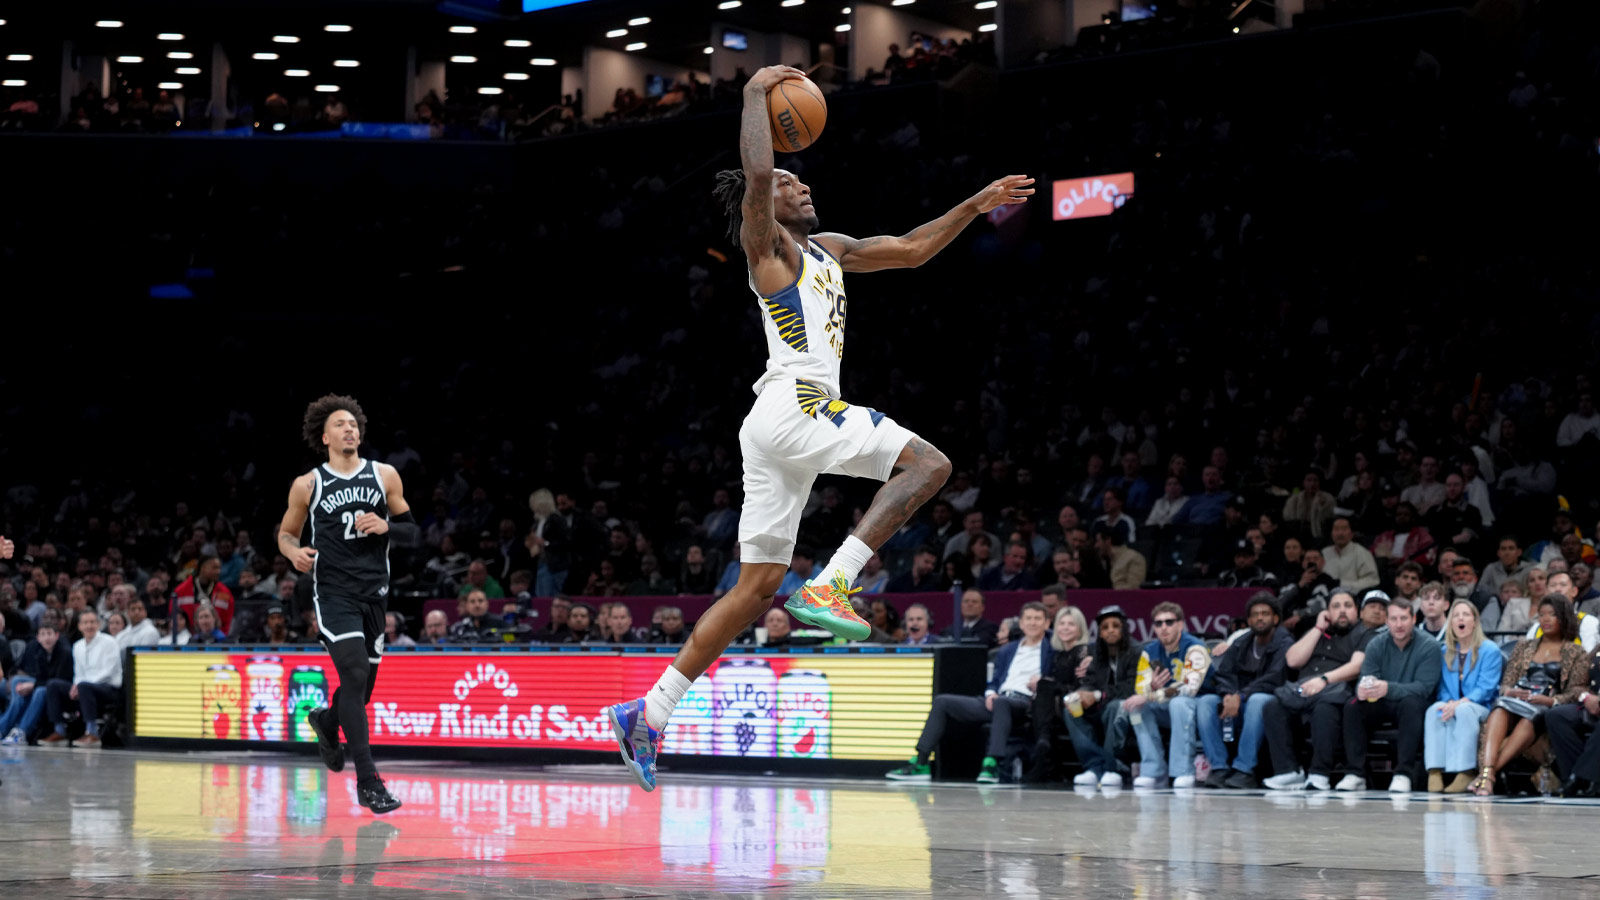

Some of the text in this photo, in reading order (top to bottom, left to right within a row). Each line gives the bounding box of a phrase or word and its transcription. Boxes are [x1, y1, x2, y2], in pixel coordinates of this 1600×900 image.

[320, 486, 382, 514] BROOKLYN
[373, 702, 618, 741] New Kind of Sod
